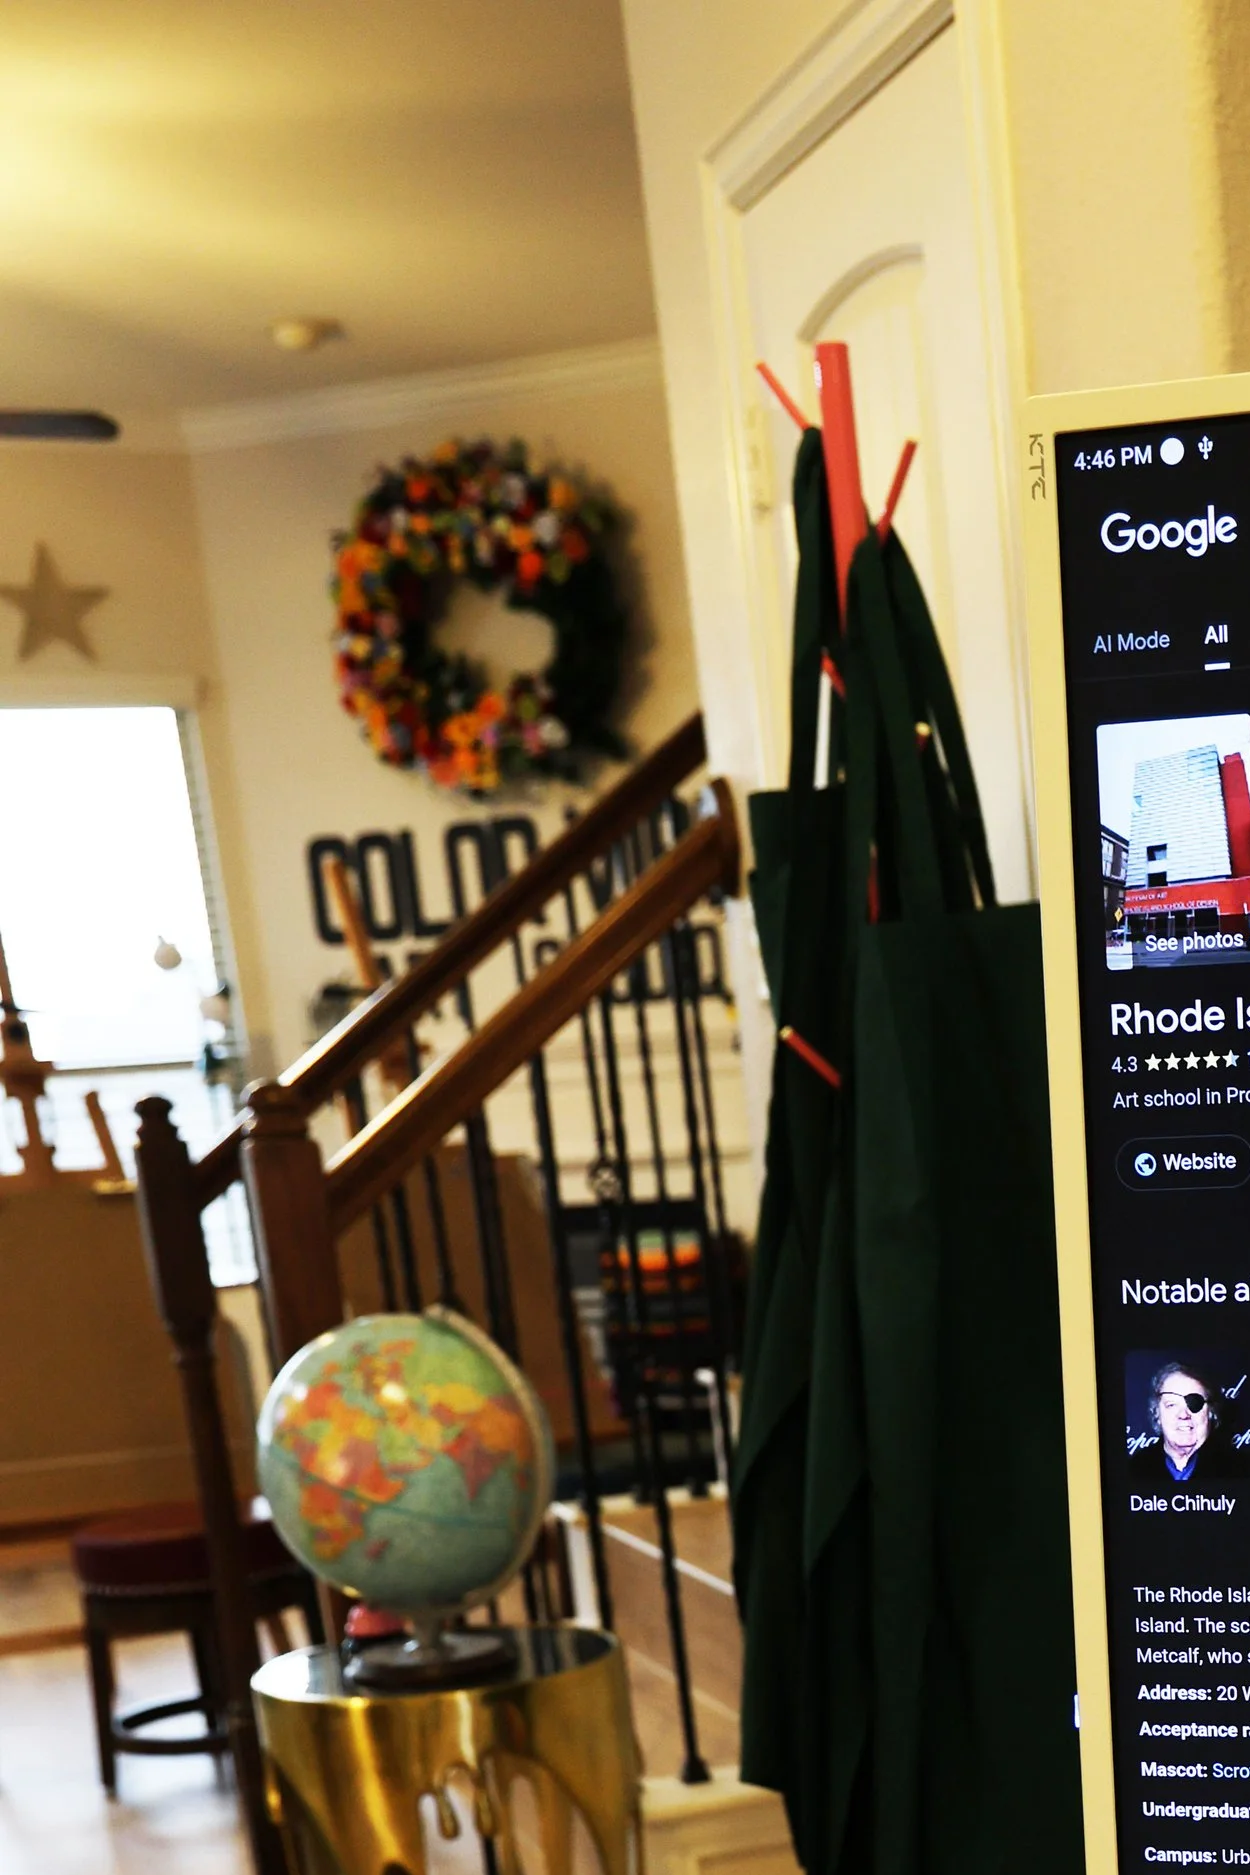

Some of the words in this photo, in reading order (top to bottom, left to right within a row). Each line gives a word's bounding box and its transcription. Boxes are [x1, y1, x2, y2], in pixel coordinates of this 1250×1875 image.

[1073, 448, 1116, 471] 4:46
[1120, 444, 1153, 467] PM
[1100, 504, 1238, 558] Google
[1093, 634, 1112, 654] AI
[1117, 630, 1171, 652] Mode
[1204, 624, 1229, 645] All
[1145, 934, 1179, 953] See
[1182, 931, 1244, 955] photos
[1110, 998, 1226, 1036] Rhode
[1111, 1055, 1138, 1074] 4.3
[1112, 1091, 1140, 1109] Art
[1143, 1087, 1201, 1107] school
[1206, 1087, 1222, 1105] in
[1162, 1151, 1237, 1171] Website
[1121, 1277, 1227, 1305] Notable
[1130, 1494, 1168, 1512] Dale
[1171, 1494, 1236, 1516] Chihuly
[1132, 1586, 1166, 1603] The
[1169, 1586, 1224, 1603] Rhode
[1137, 1683, 1212, 1701] Address:
[1216, 1685, 1238, 1701] 20
[1138, 1720, 1239, 1741] Acceptance
[1140, 1761, 1208, 1778] Mascot:
[1144, 1846, 1218, 1866] Campus:
